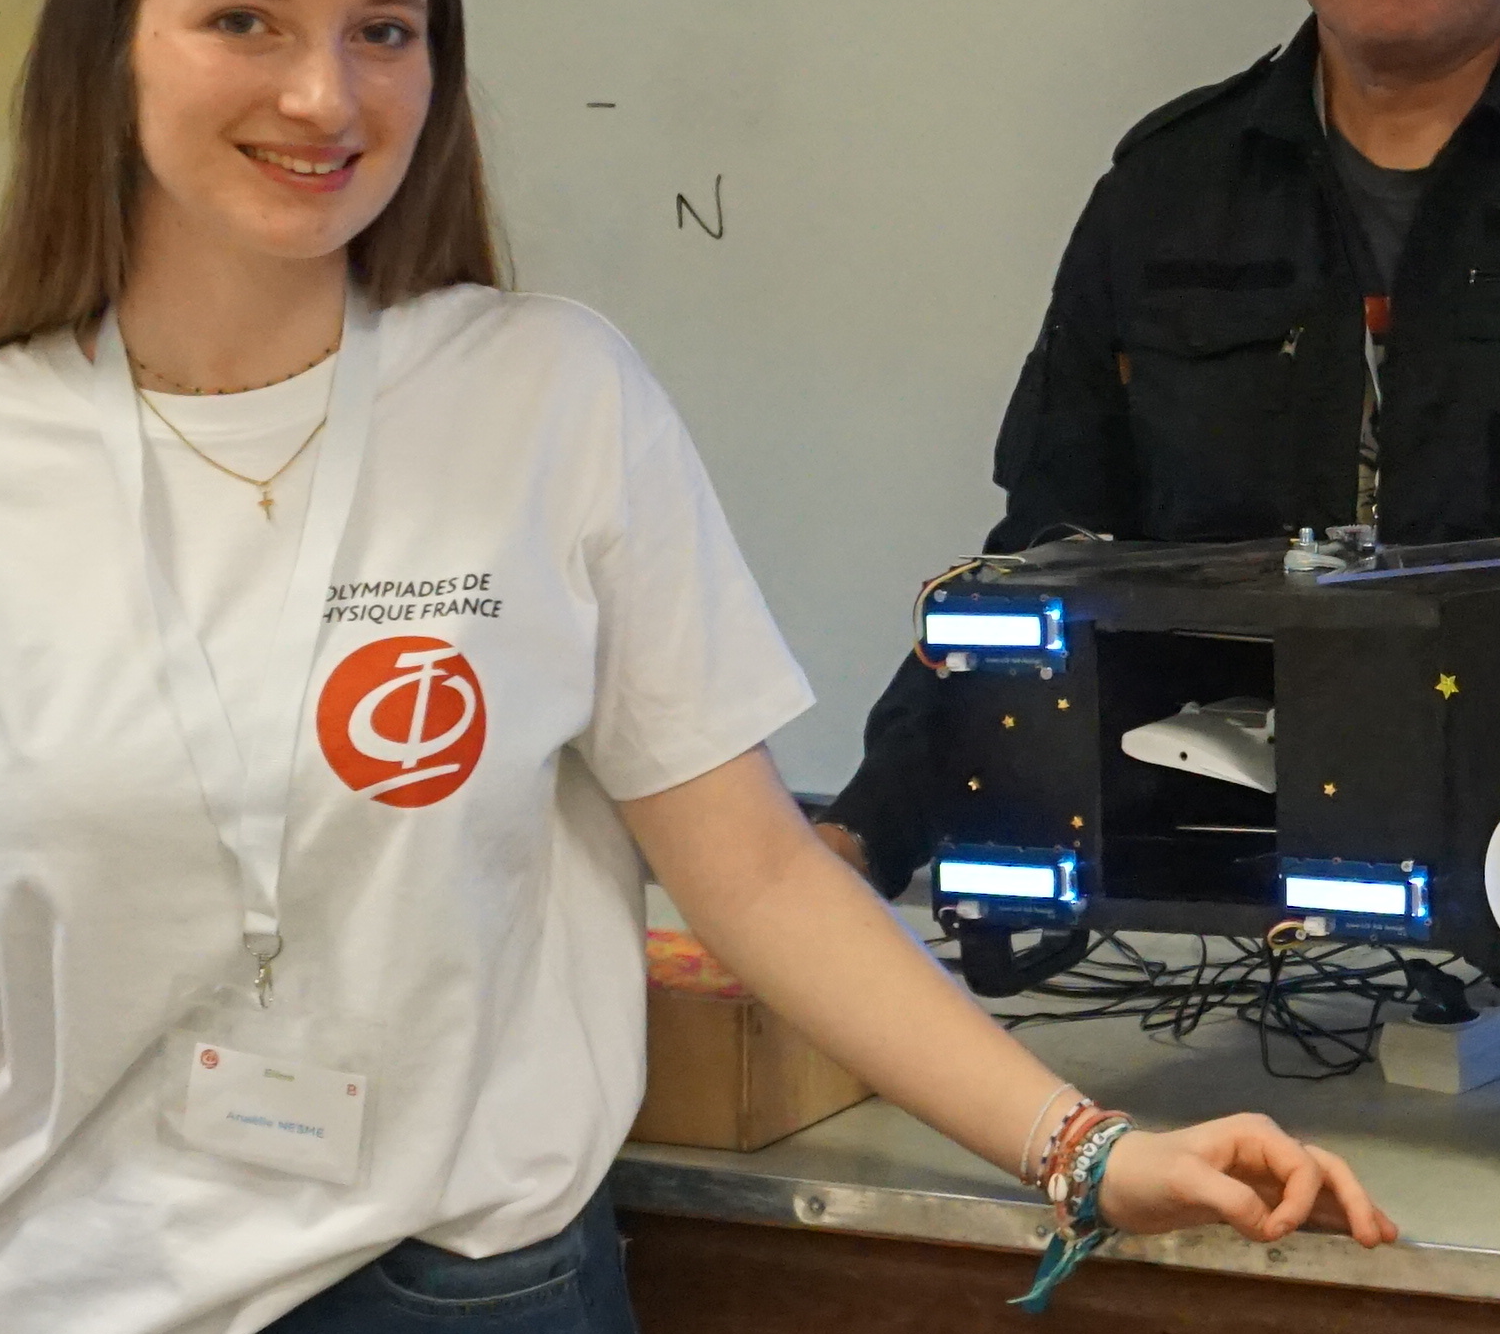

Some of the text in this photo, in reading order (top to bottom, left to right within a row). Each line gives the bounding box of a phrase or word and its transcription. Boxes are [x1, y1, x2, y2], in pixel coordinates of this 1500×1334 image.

[461, 573, 493, 591] DE
[322, 596, 504, 625] HYSIQUE FRANCE
